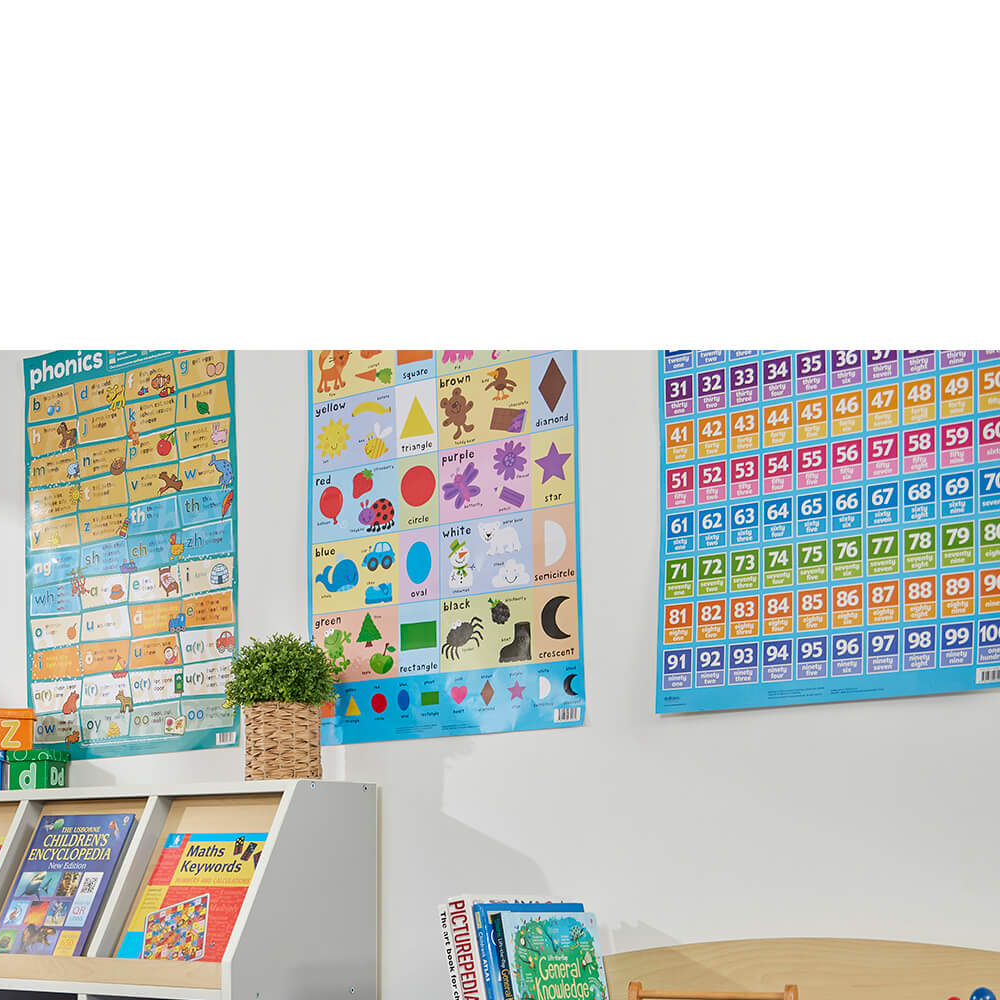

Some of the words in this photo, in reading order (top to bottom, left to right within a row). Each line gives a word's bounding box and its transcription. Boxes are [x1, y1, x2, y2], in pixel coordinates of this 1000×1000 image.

[30, 352, 103, 390] phonics
[403, 368, 428, 380] square
[440, 374, 471, 388] brown
[80, 386, 88, 399] d
[33, 399, 40, 411] b
[315, 402, 346, 417] yellow
[129, 408, 135, 421] k
[536, 414, 569, 428] diamond
[401, 442, 433, 454] triangle
[83, 455, 91, 467] n
[442, 450, 475, 466] purple
[315, 476, 331, 486] red
[545, 493, 562, 502] star
[185, 501, 200, 512] th
[408, 515, 429, 525] circle
[442, 526, 471, 538] white
[315, 547, 335, 557] blue
[534, 569, 575, 581] semicircle
[411, 589, 427, 598] oval
[444, 601, 470, 612] black
[315, 616, 342, 628] green
[908, 631, 932, 649] 98
[945, 627, 969, 645] 99
[801, 641, 823, 658] 95
[835, 638, 859, 655] 96
[871, 634, 894, 652] 97
[539, 648, 575, 659] crescent
[700, 650, 721, 668] 92
[733, 647, 753, 664] 93
[766, 644, 788, 661] 94
[400, 662, 438, 673] rectangle
[667, 654, 686, 671] 91
[19, 762, 36, 790] d
[51, 767, 64, 786] Dd
[43, 834, 109, 847] CHILDREN'S
[28, 848, 111, 860] ENCYCLOPEDIA
[187, 845, 225, 857] Maths
[180, 860, 242, 875] Keywords
[446, 949, 454, 972] book
[538, 957, 582, 979] General
